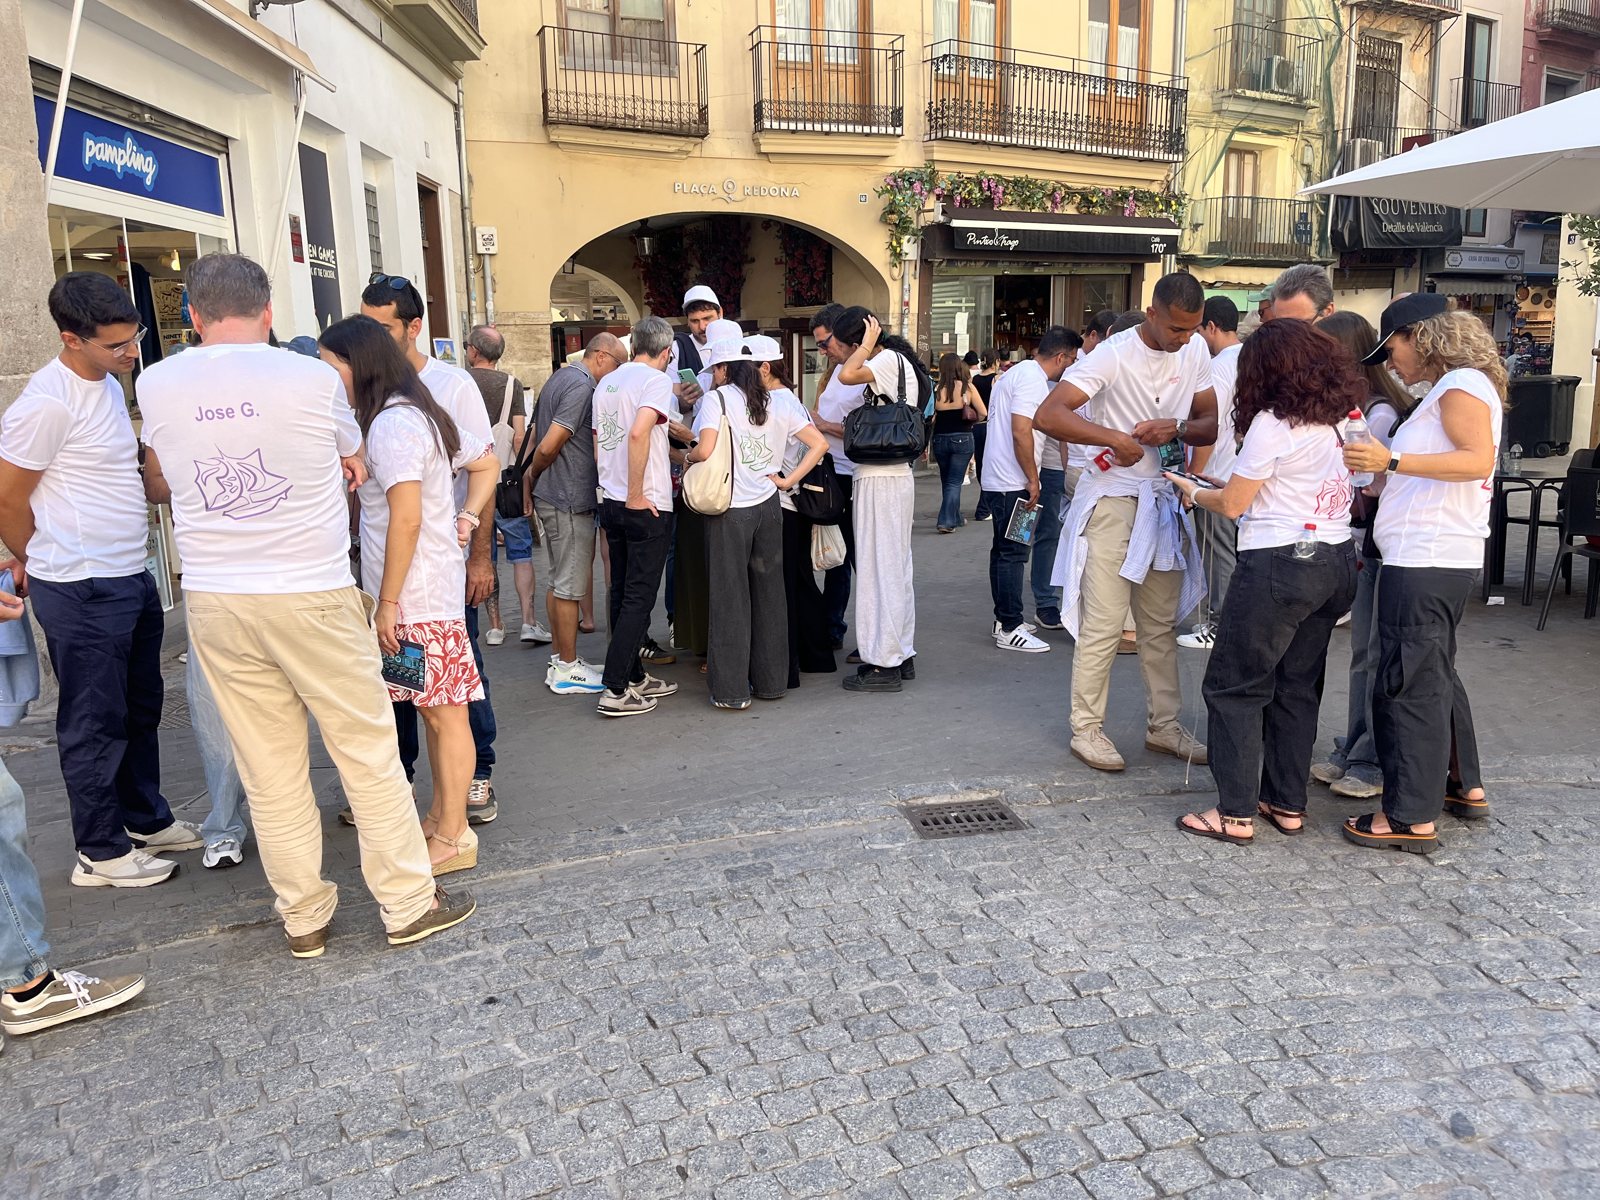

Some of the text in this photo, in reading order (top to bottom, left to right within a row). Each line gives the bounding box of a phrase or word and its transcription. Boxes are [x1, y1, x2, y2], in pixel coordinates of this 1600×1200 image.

[85, 137, 156, 186] pampling
[674, 182, 800, 198] PLAÇA REDONA
[1382, 221, 1443, 233] Detalls de València
[318, 246, 336, 265] GAME
[195, 401, 260, 422] Jose G.
[569, 675, 586, 683] HOKA
